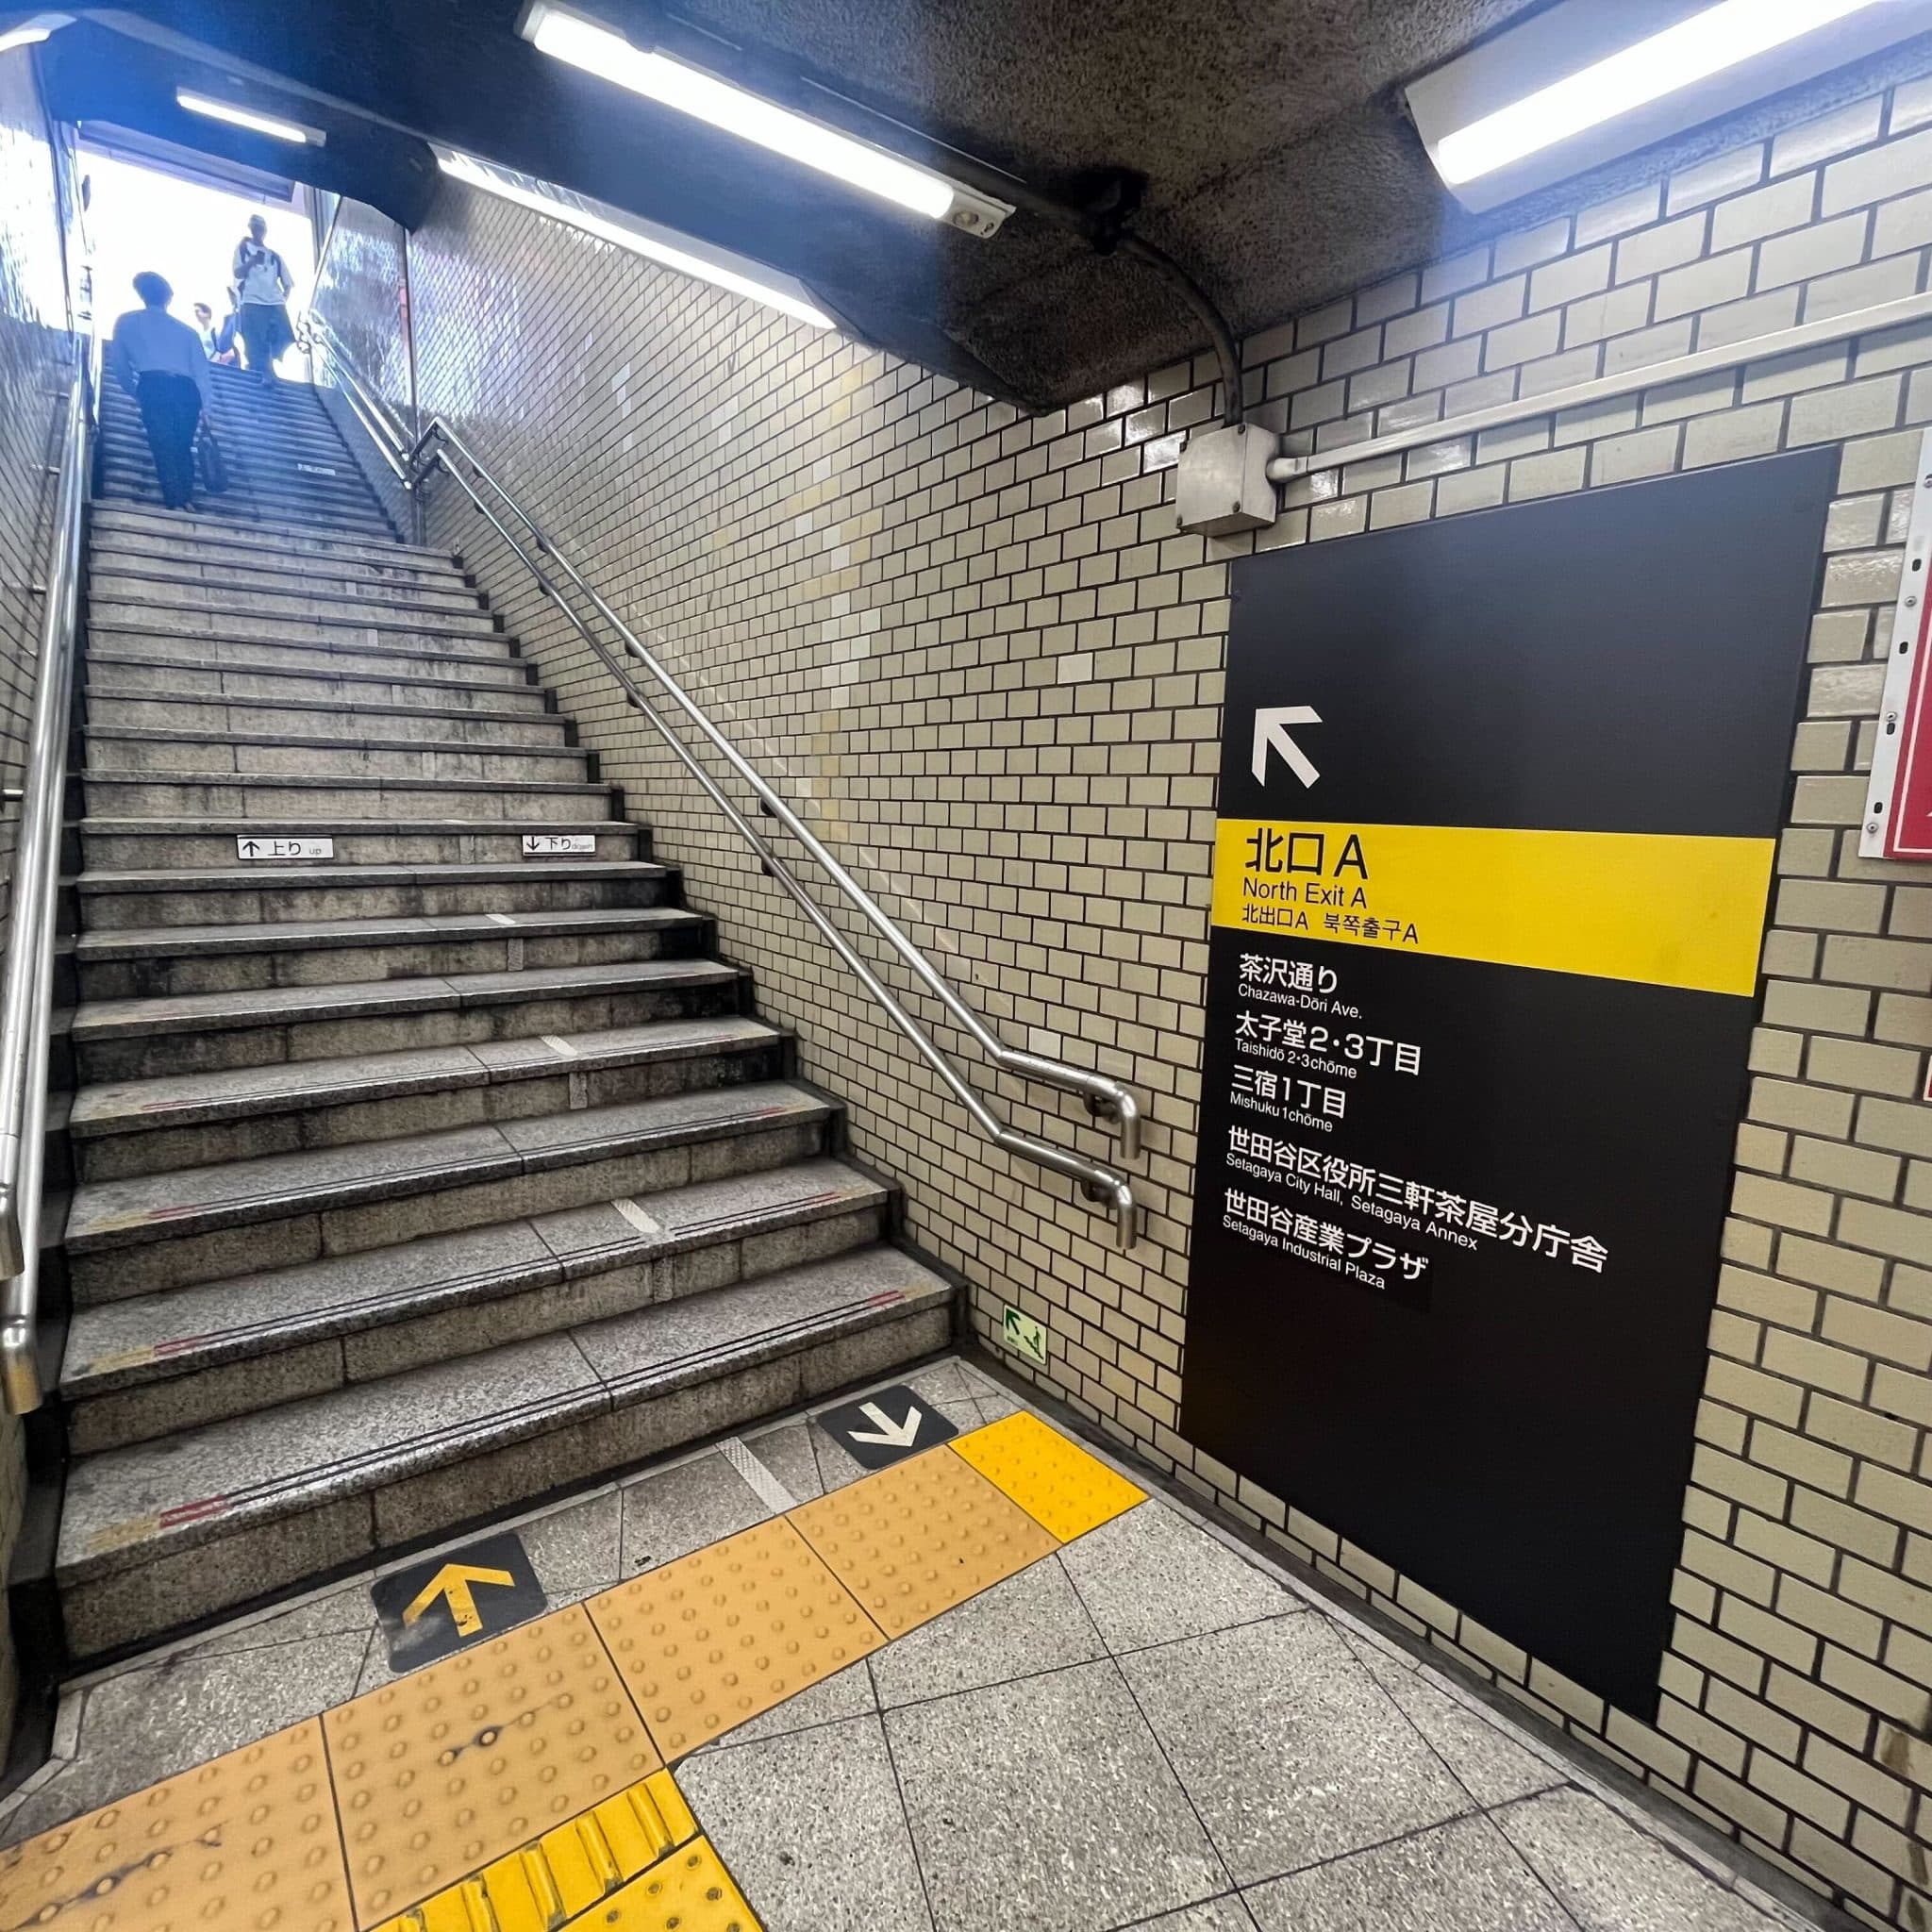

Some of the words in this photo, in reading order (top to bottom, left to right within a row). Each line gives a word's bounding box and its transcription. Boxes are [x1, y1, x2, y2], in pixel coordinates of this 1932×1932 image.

[267, 841, 301, 856] 上り
[544, 837, 572, 850] 下り
[1242, 877, 1297, 901] North
[1306, 883, 1345, 907] Exit
[1351, 887, 1368, 908] A
[1242, 904, 1309, 930] 北出口A
[1324, 912, 1419, 943] 북쪽출구A
[1239, 953, 1338, 994] 茶沢通り
[1238, 983, 1328, 1013] Chazawa-Dōri
[1331, 1001, 1363, 1020] Ave.
[1236, 1038, 1285, 1062] Taishidō
[1230, 1091, 1280, 1118] Mishuku
[1231, 1064, 1346, 1119] 三宿1丁目
[1226, 1154, 1283, 1184] Setagaya
[1285, 1173, 1311, 1196] City
[1313, 1184, 1344, 1206] Hall,
[1351, 1195, 1421, 1232] Setagaya
[1425, 1222, 1478, 1251] Annex
[1228, 1125, 1608, 1274] 世田谷区役所三軒茶屋分庁舎
[1224, 1188, 1428, 1280] 世田谷産業プラザ
[1223, 1214, 1279, 1248] Setagaya
[1282, 1236, 1341, 1273] Industrial
[1345, 1261, 1386, 1290] Plaza
